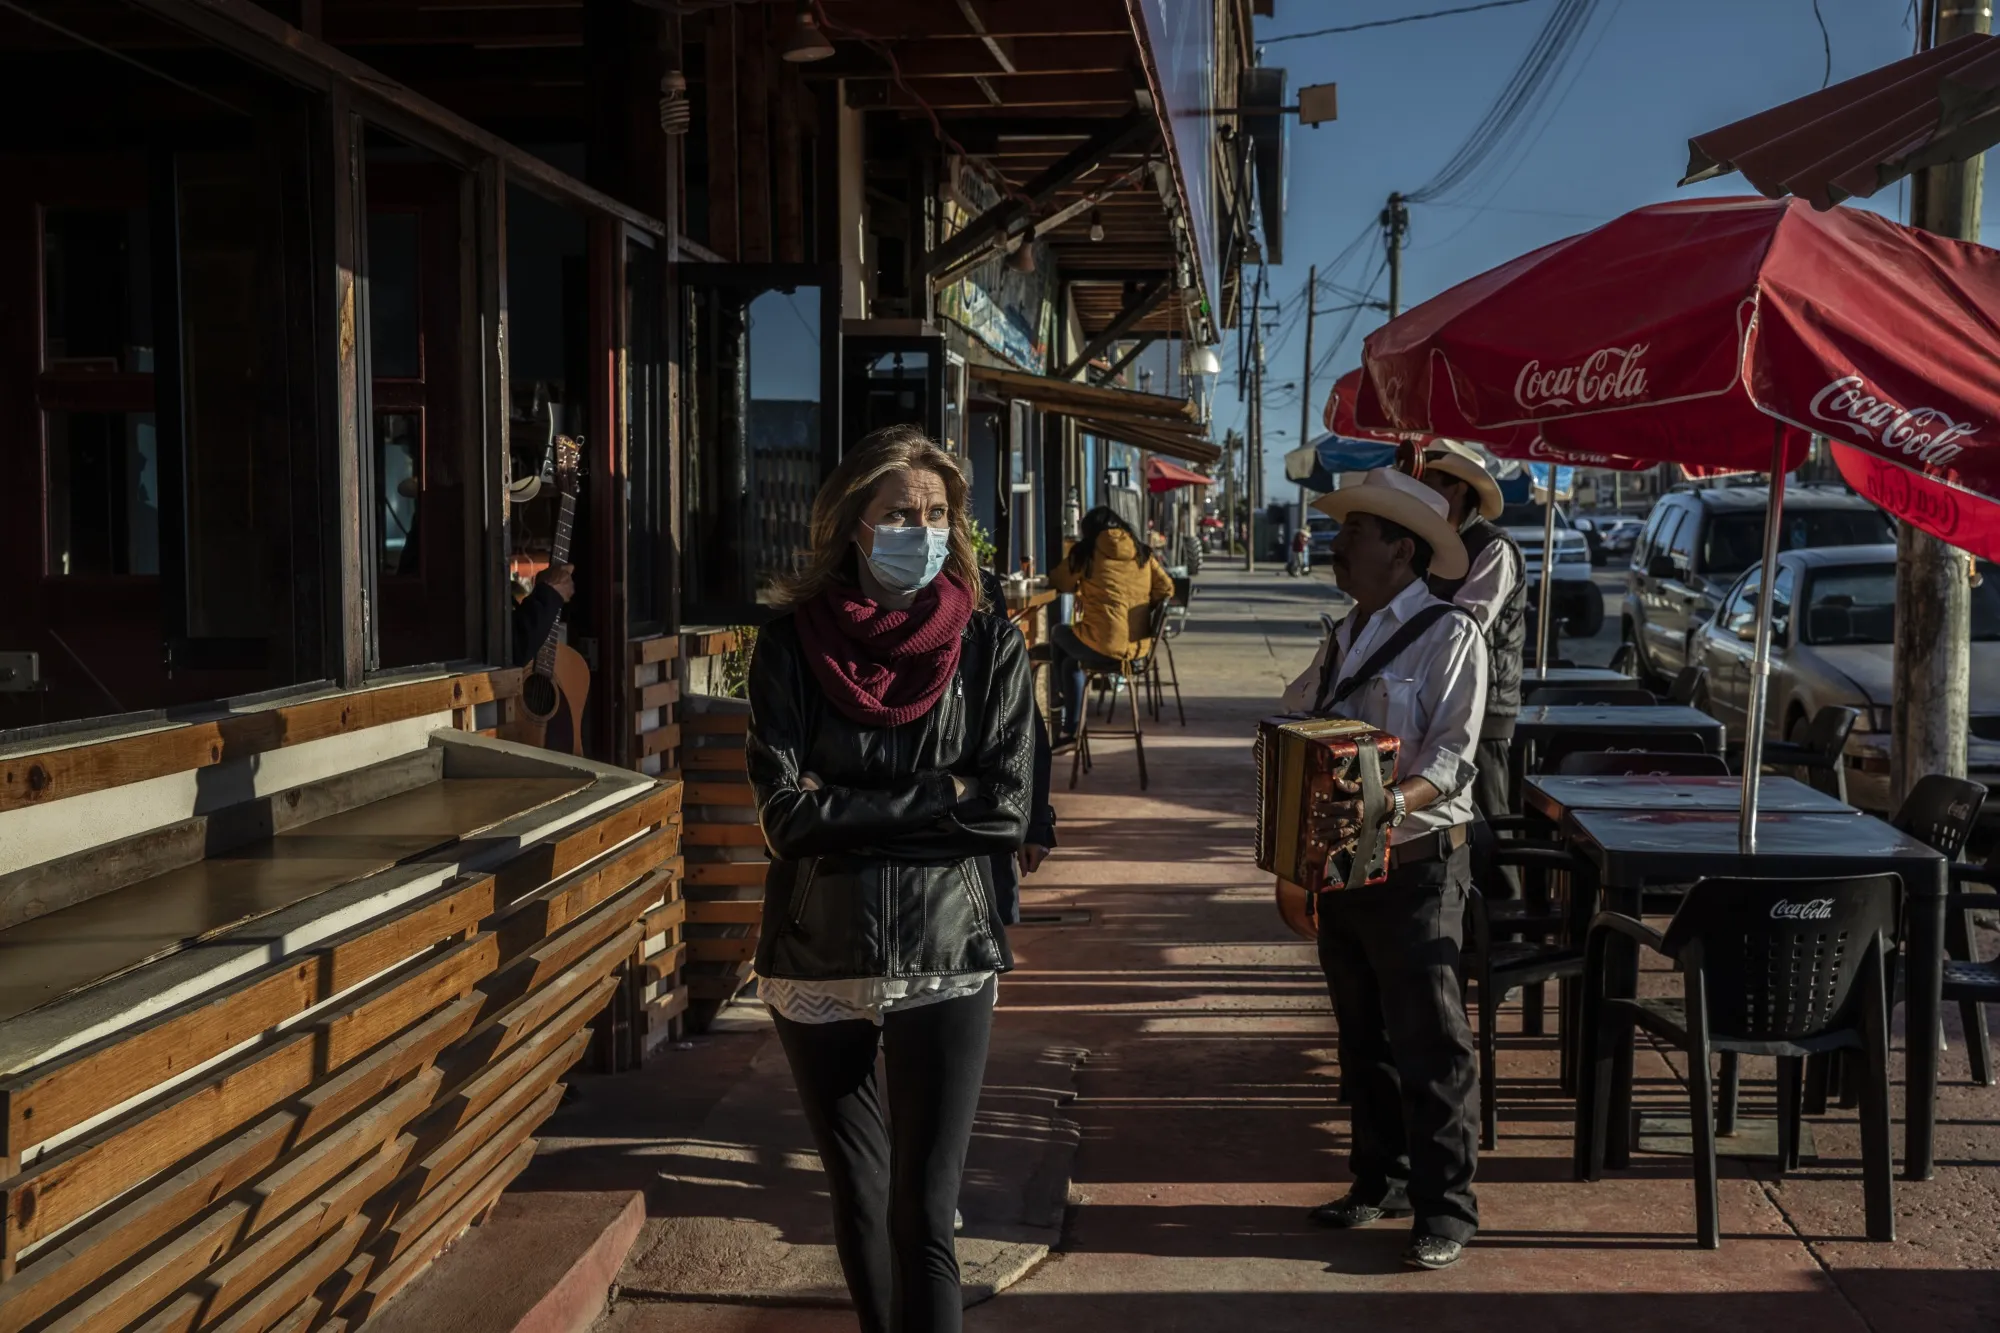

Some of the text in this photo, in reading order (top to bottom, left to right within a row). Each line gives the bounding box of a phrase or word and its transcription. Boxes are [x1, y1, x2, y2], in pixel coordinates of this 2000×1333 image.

[1514, 342, 1651, 410] Coca-Cola
[1809, 375, 1982, 466] Coca-Cola
[1769, 897, 1836, 919] Coca-Cola
